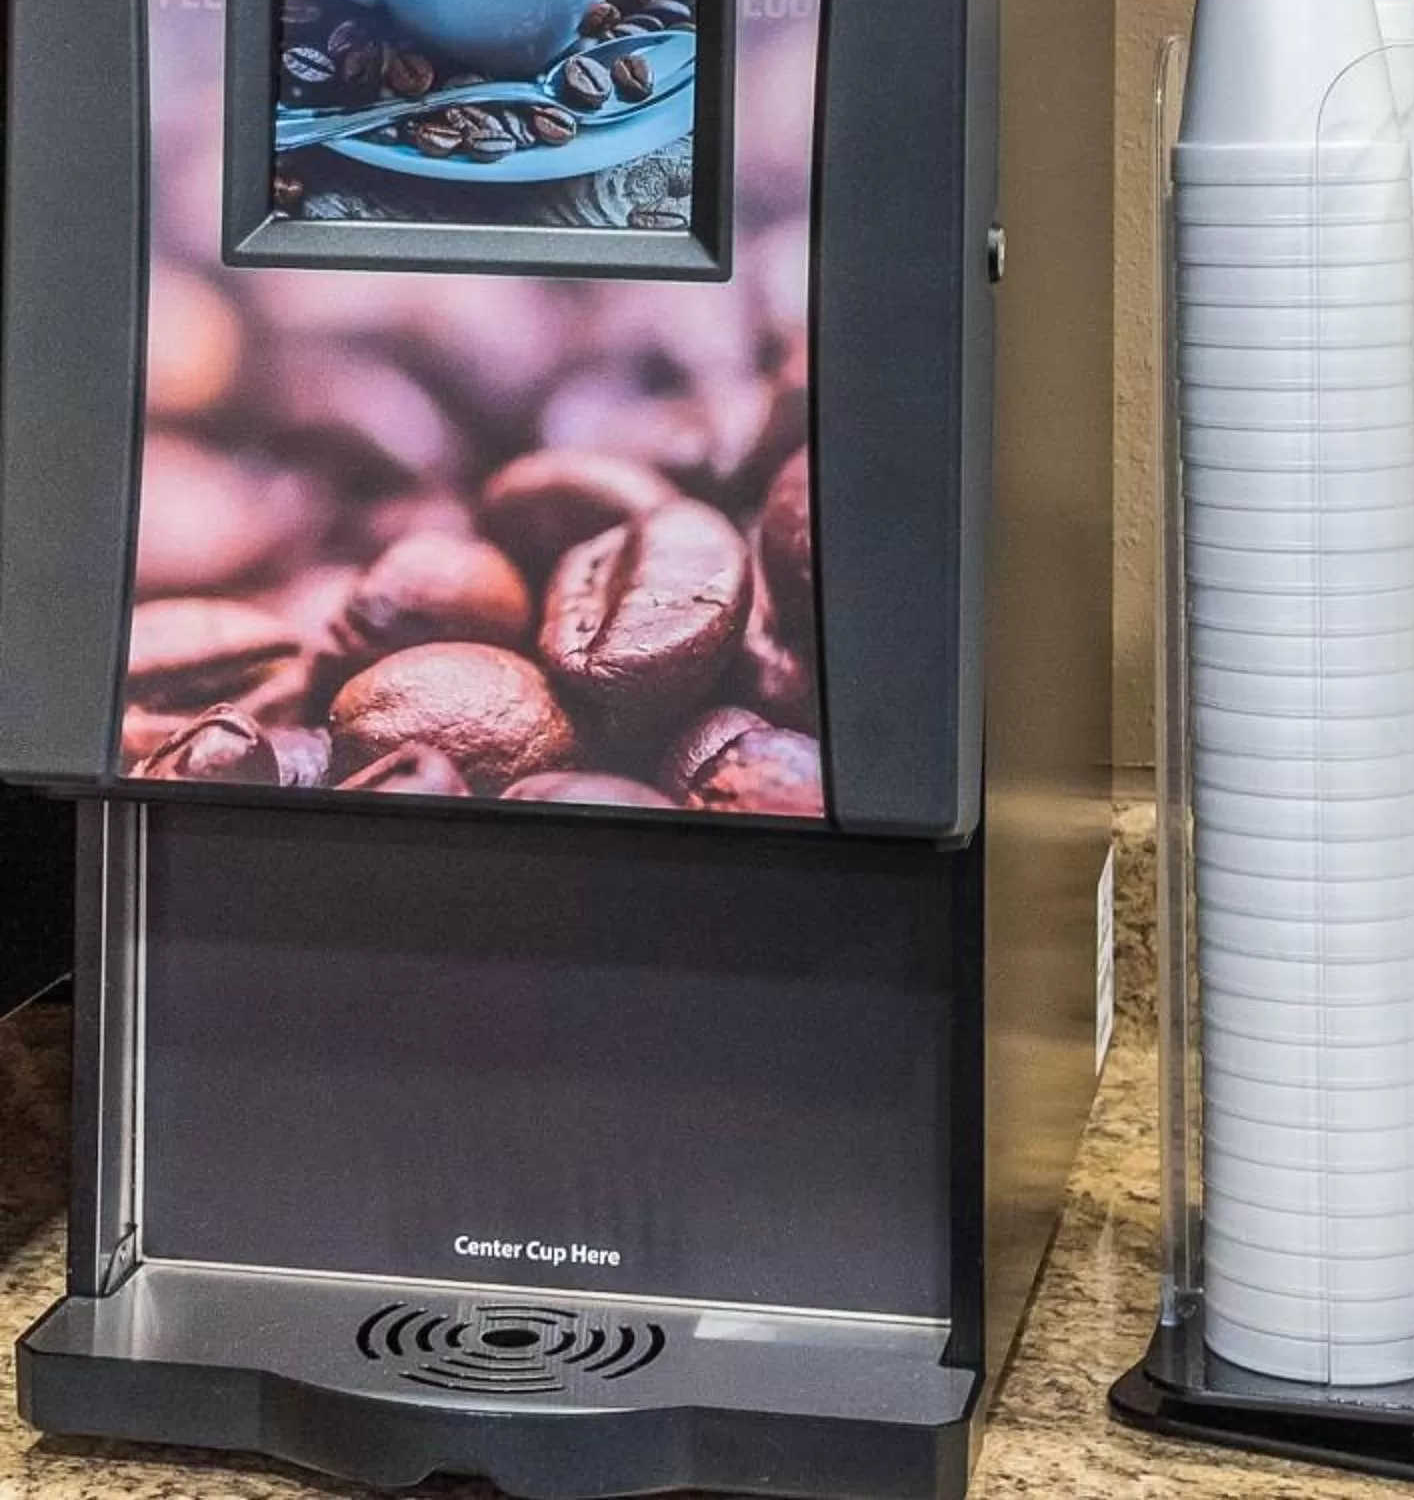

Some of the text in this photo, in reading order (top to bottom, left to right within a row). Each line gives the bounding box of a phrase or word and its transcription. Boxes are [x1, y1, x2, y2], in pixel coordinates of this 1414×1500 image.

[454, 1235, 621, 1267] Center Cup Here
